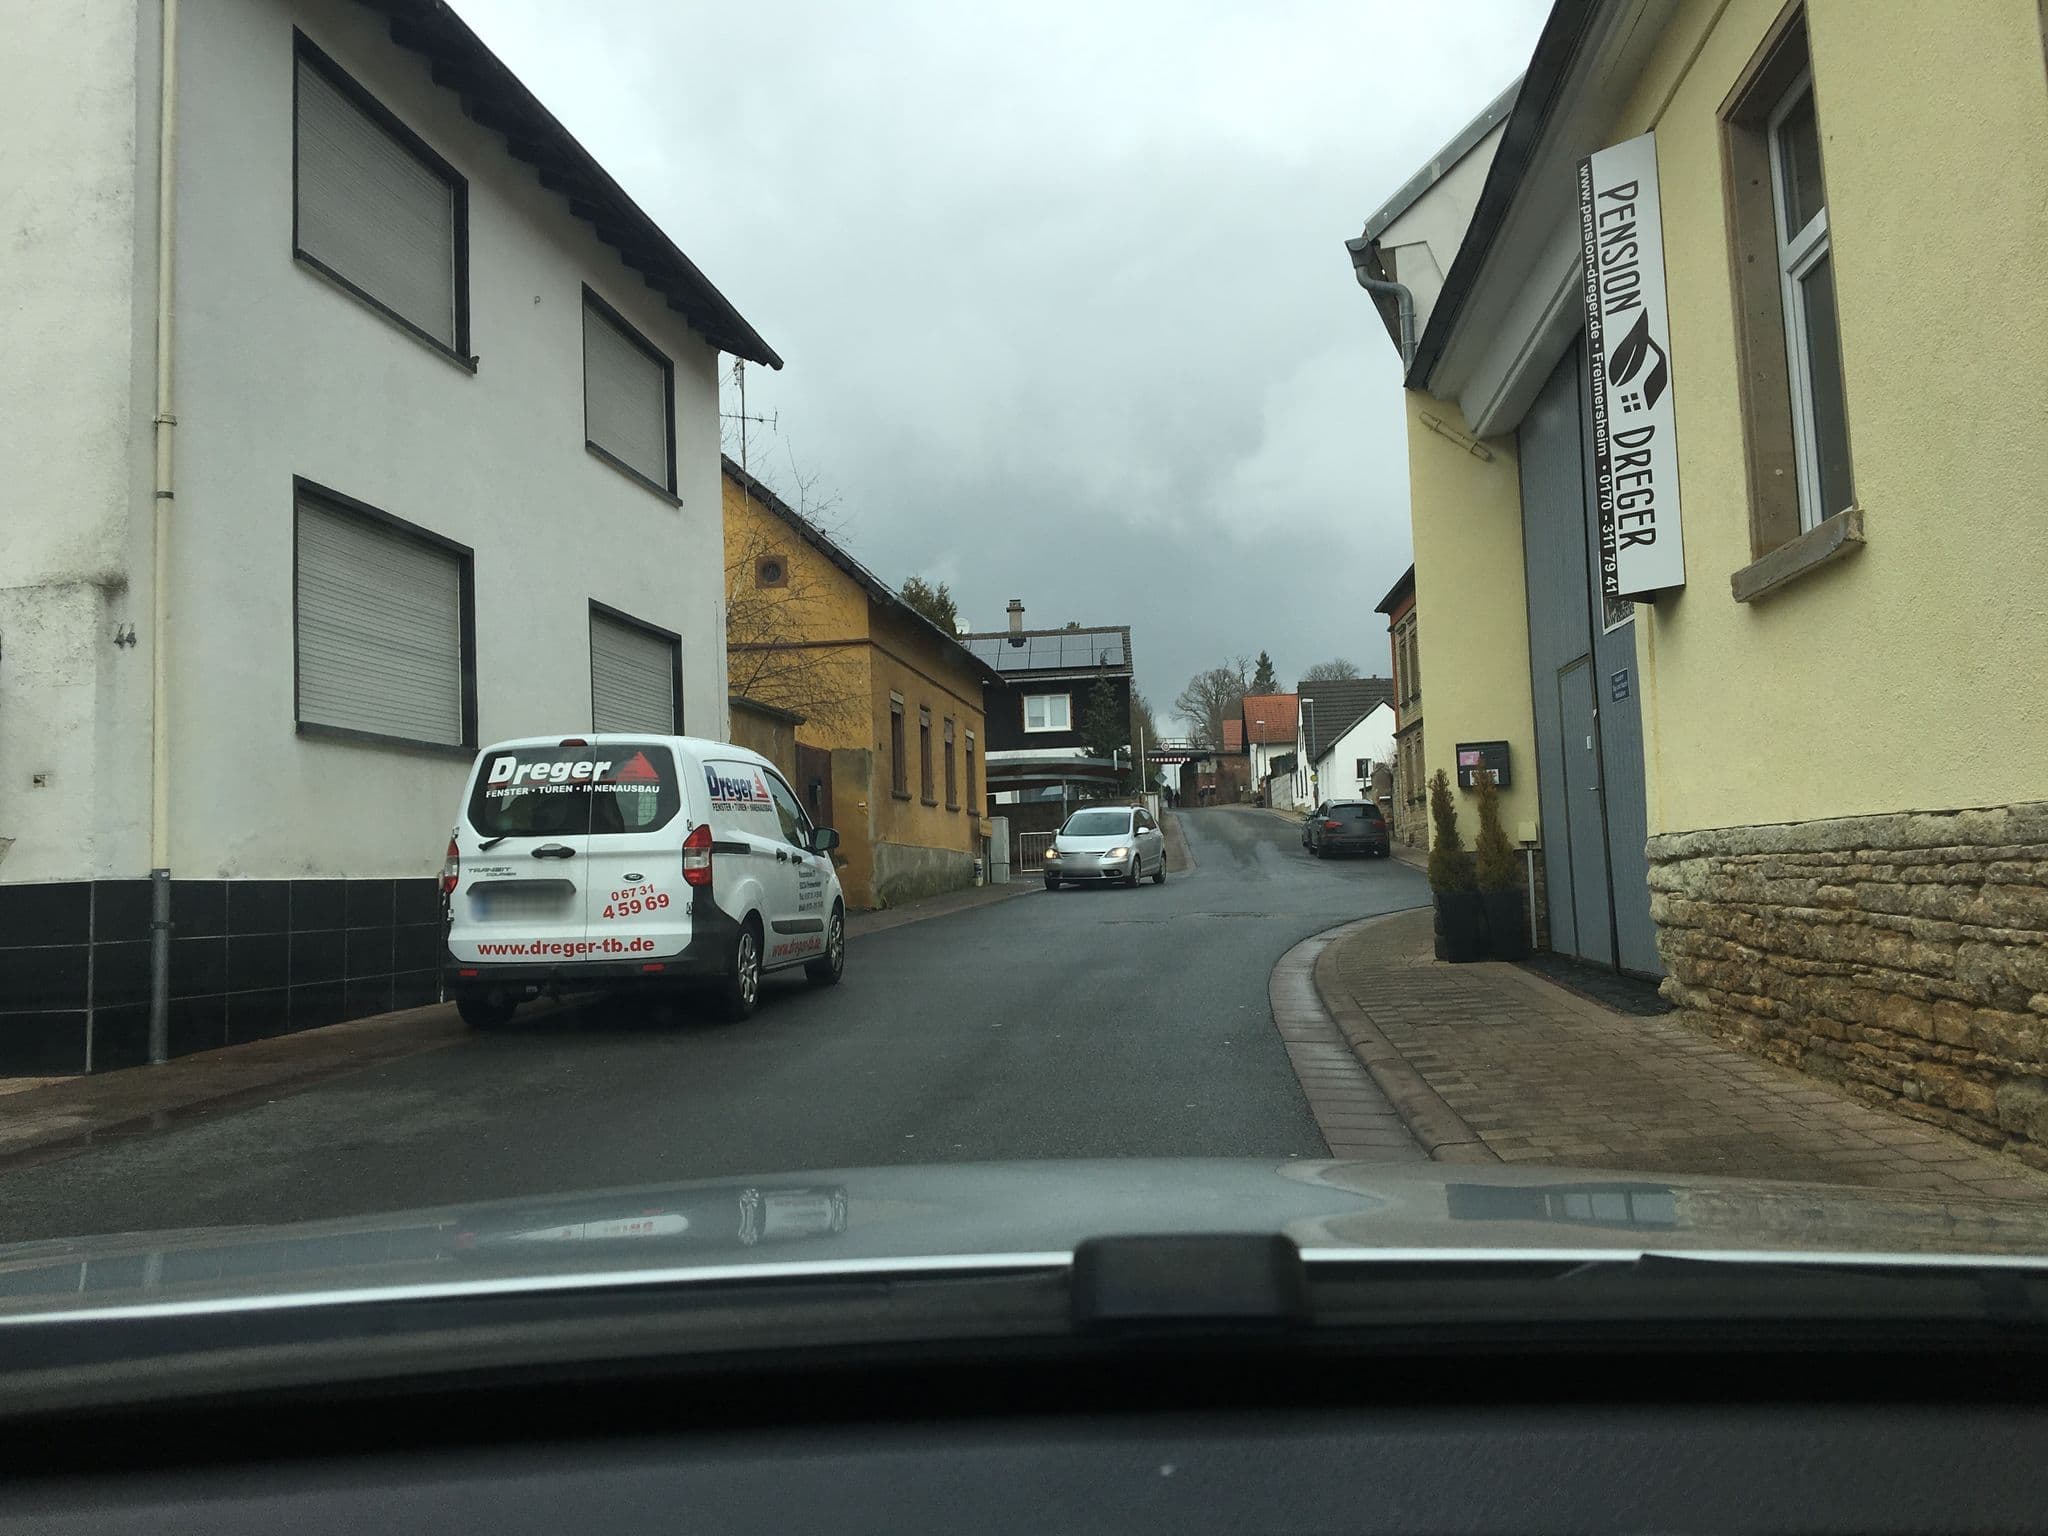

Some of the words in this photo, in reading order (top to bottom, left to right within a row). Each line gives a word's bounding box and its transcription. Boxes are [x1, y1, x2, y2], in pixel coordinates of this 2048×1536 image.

[1580, 164, 1602, 338] www.pension-dreger.de
[1598, 179, 1642, 316] PENSION
[1592, 351, 1608, 457] Freimersheim
[1600, 474, 1612, 511] 0170
[1613, 425, 1657, 551] DREGER
[1602, 523, 1615, 549] 311
[1604, 553, 1616, 572] 79
[1605, 575, 1618, 593] 41
[488, 756, 612, 785] Dreger
[704, 765, 753, 802] Dreger
[486, 787, 529, 798] FENSTER
[538, 785, 573, 794] TÜREN
[583, 784, 660, 794] INNENAUSBAU
[477, 938, 654, 957] www.dreger-tb.de
